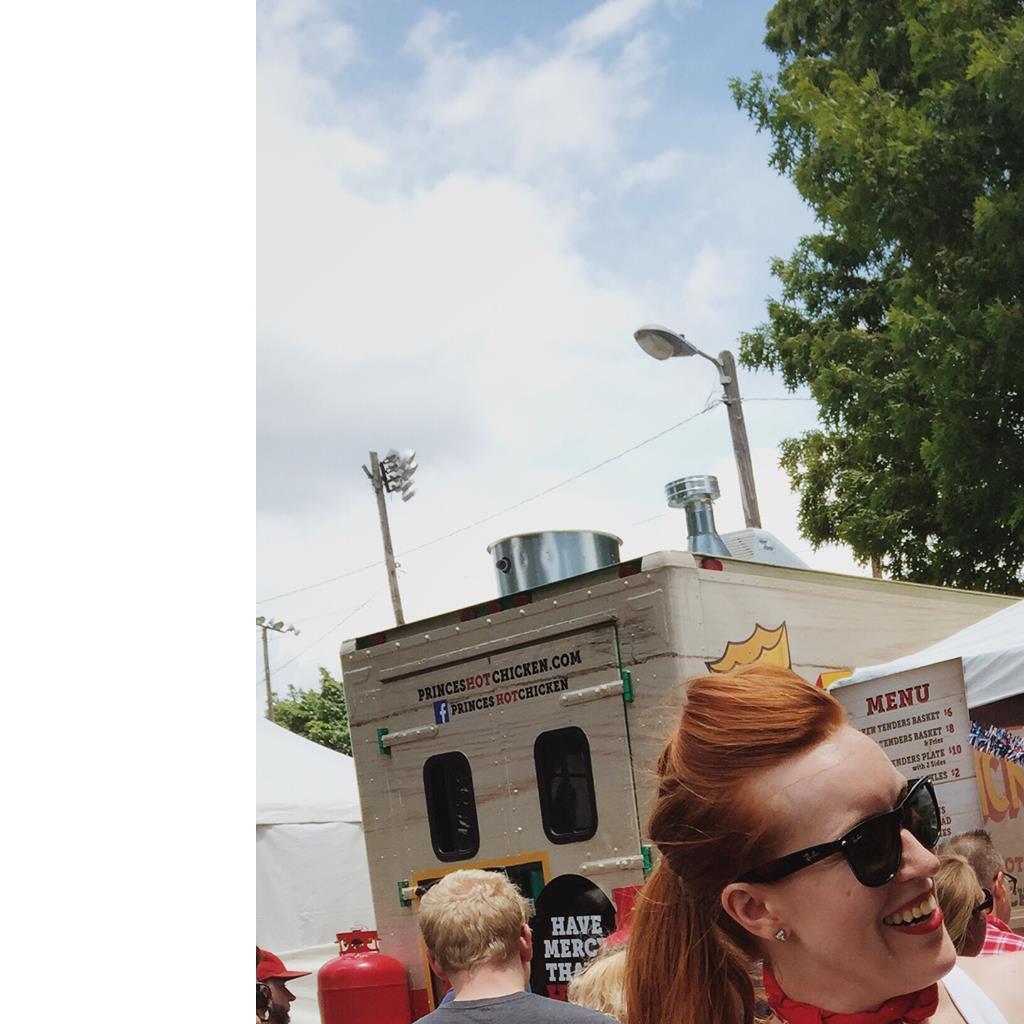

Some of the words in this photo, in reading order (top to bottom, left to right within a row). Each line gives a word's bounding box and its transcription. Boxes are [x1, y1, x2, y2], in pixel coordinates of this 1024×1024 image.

[866, 683, 930, 716] MENU
[877, 718, 911, 733] TENDERS
[912, 710, 941, 725] BASKET
[943, 707, 953, 717] $6
[913, 727, 942, 741] BASKET
[945, 723, 955, 733] $8
[922, 749, 945, 761] PLATE
[948, 745, 962, 755] $10
[951, 768, 960, 778] $2
[550, 915, 603, 936] HAVE
